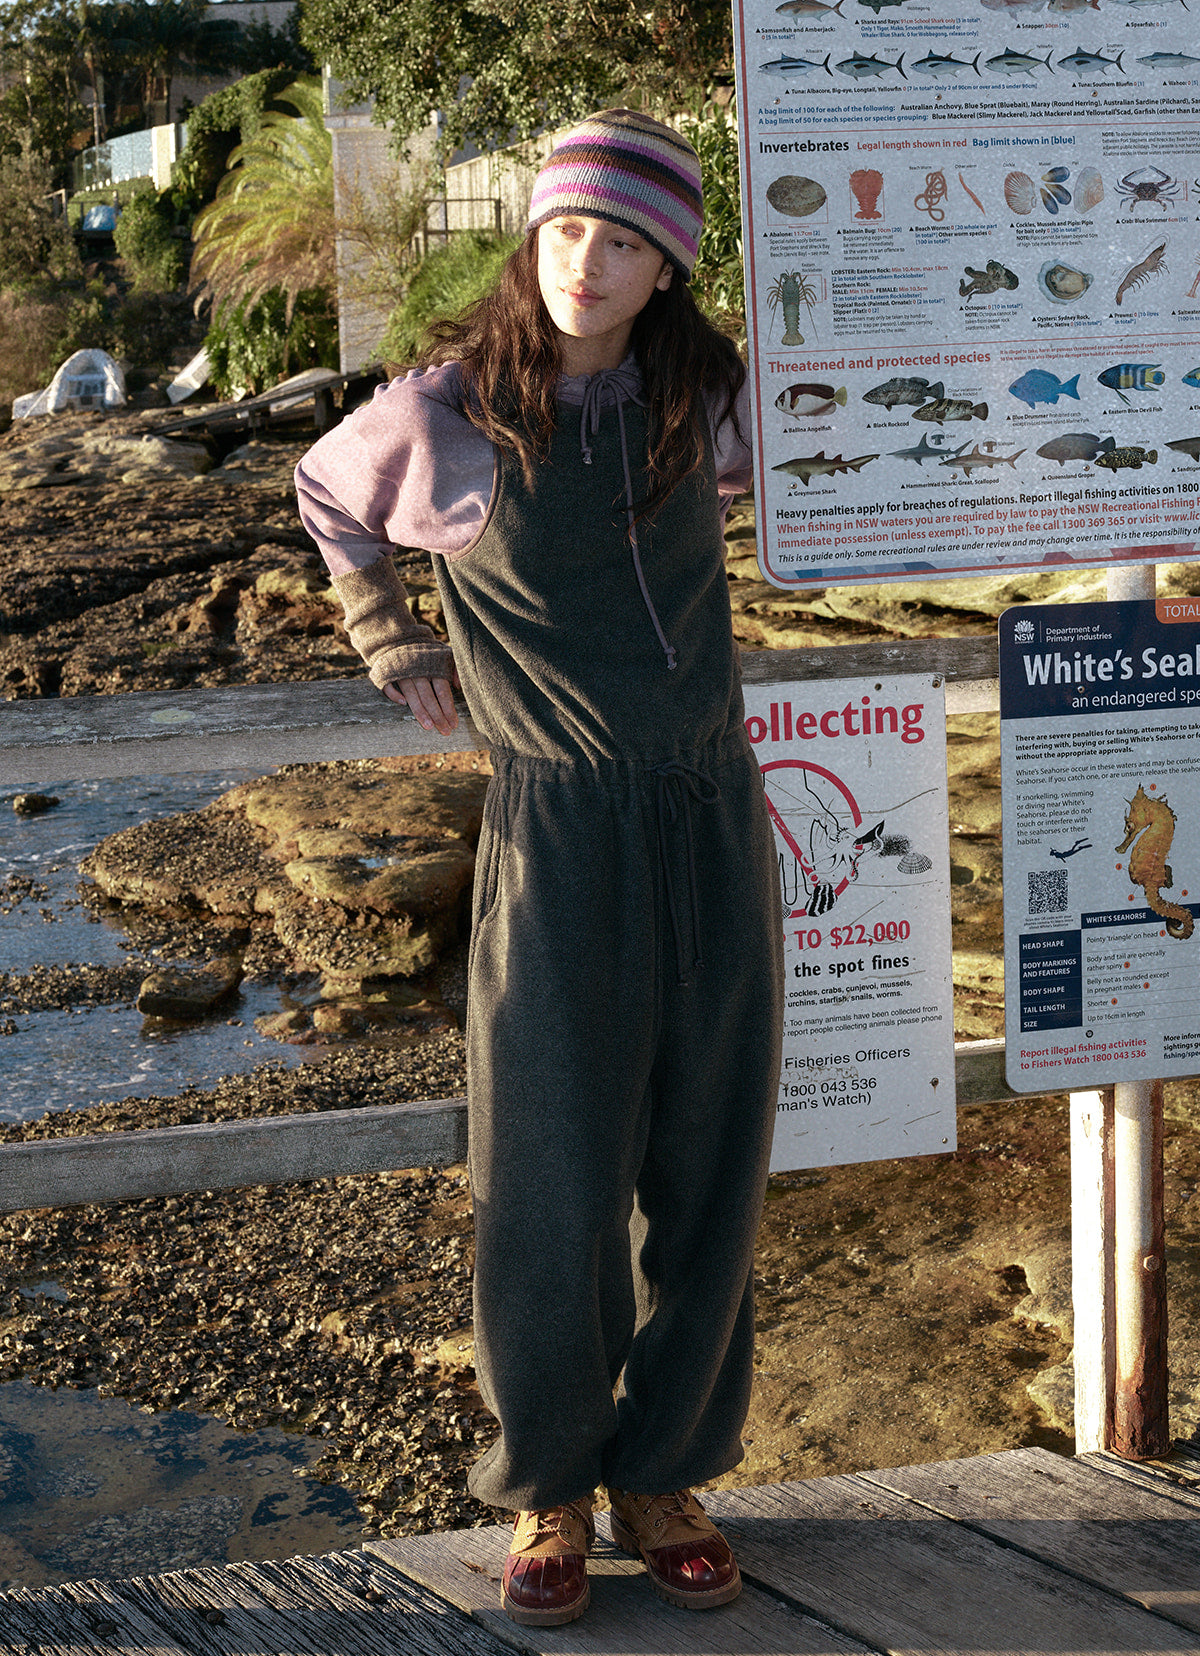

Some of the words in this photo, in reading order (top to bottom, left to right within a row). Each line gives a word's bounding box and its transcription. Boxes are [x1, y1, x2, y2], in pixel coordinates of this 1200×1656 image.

[760, 140, 849, 153] Invertebrates
[858, 141, 880, 151] Legal
[883, 140, 910, 150] length
[913, 140, 940, 148] shown
[943, 139, 950, 147] in
[953, 138, 966, 147] red
[973, 139, 988, 148] Bag
[991, 138, 1010, 146] limit
[1012, 137, 1039, 145] shown
[1051, 136, 1075, 145] [blue]
[768, 358, 844, 373] Threatened
[848, 356, 873, 369] and
[877, 353, 940, 370] protected
[944, 351, 990, 367] species
[776, 509, 807, 520] Heavy
[810, 505, 854, 519] penalties
[857, 503, 884, 516] apply
[887, 502, 900, 512] for
[903, 499, 946, 512] breaches
[949, 498, 958, 507] of
[961, 496, 1017, 509] regulations.
[1020, 492, 1052, 504] Report
[1054, 490, 1082, 502] illegal
[1085, 489, 1118, 499] fishing
[1119, 485, 1160, 496] activities
[1177, 483, 1199, 492] 1800
[777, 524, 805, 534] When
[808, 521, 841, 532] fishing
[844, 520, 853, 529] in
[856, 518, 878, 528] NSW
[881, 518, 913, 526] waters
[916, 517, 933, 527] you
[953, 510, 994, 524] required
[996, 510, 1008, 521] by
[1008, 509, 1026, 518] law
[1029, 509, 1038, 518] to
[1039, 508, 1058, 519] pay
[1060, 506, 1076, 517] the
[1078, 504, 1099, 514] NSW
[1102, 500, 1159, 512] Recreational
[1161, 498, 1194, 509] Fishing
[778, 536, 832, 548] immediate
[834, 532, 888, 545] possession
[892, 530, 926, 541] (unless
[928, 526, 971, 538] exempt).
[974, 526, 986, 537] To
[988, 525, 1004, 536] pay
[1005, 523, 1023, 536] the
[1026, 522, 1040, 532] fee
[1043, 520, 1059, 530] call
[1063, 519, 1085, 528] 1300
[1088, 518, 1105, 529] 369
[1108, 516, 1124, 527] 365
[1140, 514, 1159, 523] visit
[779, 554, 794, 562] This
[811, 552, 833, 562] guide
[835, 550, 853, 560] only.
[879, 545, 926, 556] recreational
[927, 544, 946, 552] rules
[962, 542, 984, 550] under
[985, 540, 1012, 548] review
[1012, 538, 1028, 546] and
[1029, 539, 1045, 547] may
[1047, 536, 1074, 546] change
[1141, 528, 1192, 538] responsibility
[1164, 605, 1200, 617] TOTAL
[1014, 633, 1034, 642] NSW
[1046, 626, 1090, 635] Department
[1023, 650, 1133, 685] White's
[1142, 644, 1200, 678] Sea
[1072, 697, 1088, 708] an
[1092, 688, 1175, 707] endangered
[1072, 730, 1103, 739] penalties
[1142, 725, 1178, 733] attempting
[1057, 749, 1098, 758] appropriate
[1099, 746, 1133, 755] approvals.
[1114, 913, 1146, 921] SEAHORSE
[794, 929, 822, 949] TO
[830, 921, 910, 949] $22,000
[1043, 940, 1064, 948] SHAPE
[794, 962, 820, 977] the
[829, 959, 864, 978] spot
[872, 955, 909, 970] fines
[1042, 959, 1076, 967] MARKINGS
[789, 990, 819, 998] cockles,
[846, 983, 878, 992] cunjevoi,
[880, 980, 912, 988] mussels,
[1044, 986, 1064, 994] SHAPE
[788, 999, 817, 1007] urchins,
[851, 993, 874, 1001] snails,
[1039, 1004, 1065, 1012] LENGTH
[1021, 1048, 1048, 1058] Report
[1051, 1045, 1076, 1055] illegal
[1078, 1043, 1106, 1052] fishing
[1109, 1038, 1146, 1049] activities
[785, 1054, 850, 1069] Fisheries
[856, 1049, 910, 1062] Officers
[1032, 1060, 1061, 1068] Fishers
[1064, 1055, 1089, 1065] Watch
[1092, 1053, 1112, 1062] 1800
[1114, 1051, 1128, 1060] 043
[1132, 1050, 1146, 1058] 536
[783, 1084, 816, 1097] 1800
[821, 1081, 846, 1093] 043
[852, 1078, 876, 1090] 536
[823, 1092, 871, 1107] Watch)
